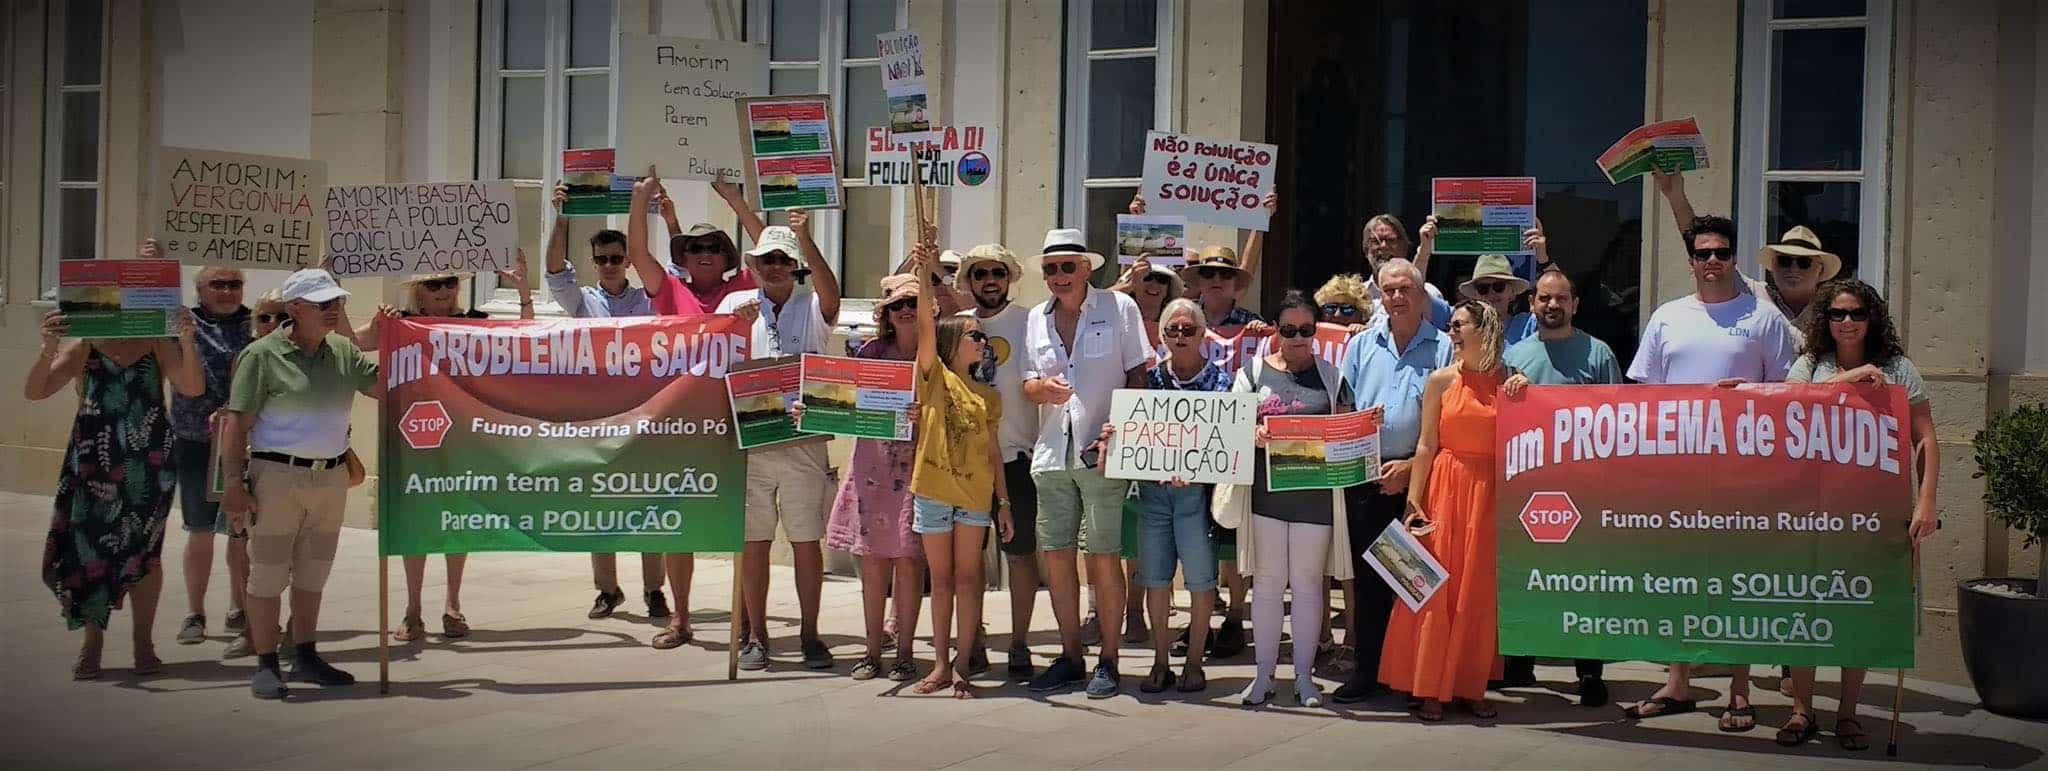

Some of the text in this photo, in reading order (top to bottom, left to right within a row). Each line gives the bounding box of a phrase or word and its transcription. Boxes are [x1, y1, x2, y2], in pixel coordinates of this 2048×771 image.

[657, 46, 729, 71] Amorim
[664, 81, 690, 95] tem
[693, 87, 702, 96] a
[665, 105, 708, 127] Parem
[678, 136, 689, 146] a
[172, 157, 307, 191] AMORIM:
[1183, 161, 1198, 179] a
[170, 181, 314, 216] VERGONHA
[325, 184, 487, 209] AMORIM: BASTA!
[165, 210, 311, 241] RESPEITA a LEI
[327, 201, 510, 231] PARE A POLUIÇÃO
[168, 238, 310, 265] e o AMBIENTE
[330, 226, 487, 253] CONCLUA AS
[331, 252, 404, 275] OBRAS
[1729, 327, 1750, 338] LDN
[429, 327, 598, 376] PROBLEMA
[605, 330, 641, 377] de
[650, 323, 746, 379] SAÚDE
[1129, 397, 1247, 424] AMORIM:
[408, 418, 445, 432] STOP
[471, 417, 532, 437] Fumo
[537, 420, 630, 439] Suberina
[636, 417, 696, 436] Ruído
[703, 418, 728, 436] Pó
[1121, 421, 1225, 450] PAREM A
[1505, 393, 1901, 482] um PROBLEMA de SAÚDE
[1120, 446, 1239, 480] POLUIÇÃO!
[405, 468, 718, 496] Amorim tem a SOLUÇÃO
[441, 505, 682, 533] Parem a POLUIÇÃO
[1528, 509, 1573, 525] STOP
[1600, 510, 1881, 533] Fumo Suberina Ruído Pó
[1526, 569, 1873, 600] Amorim tem a SOLUÇÃO
[1562, 612, 1833, 643] Parem a POLUIÇÃO
